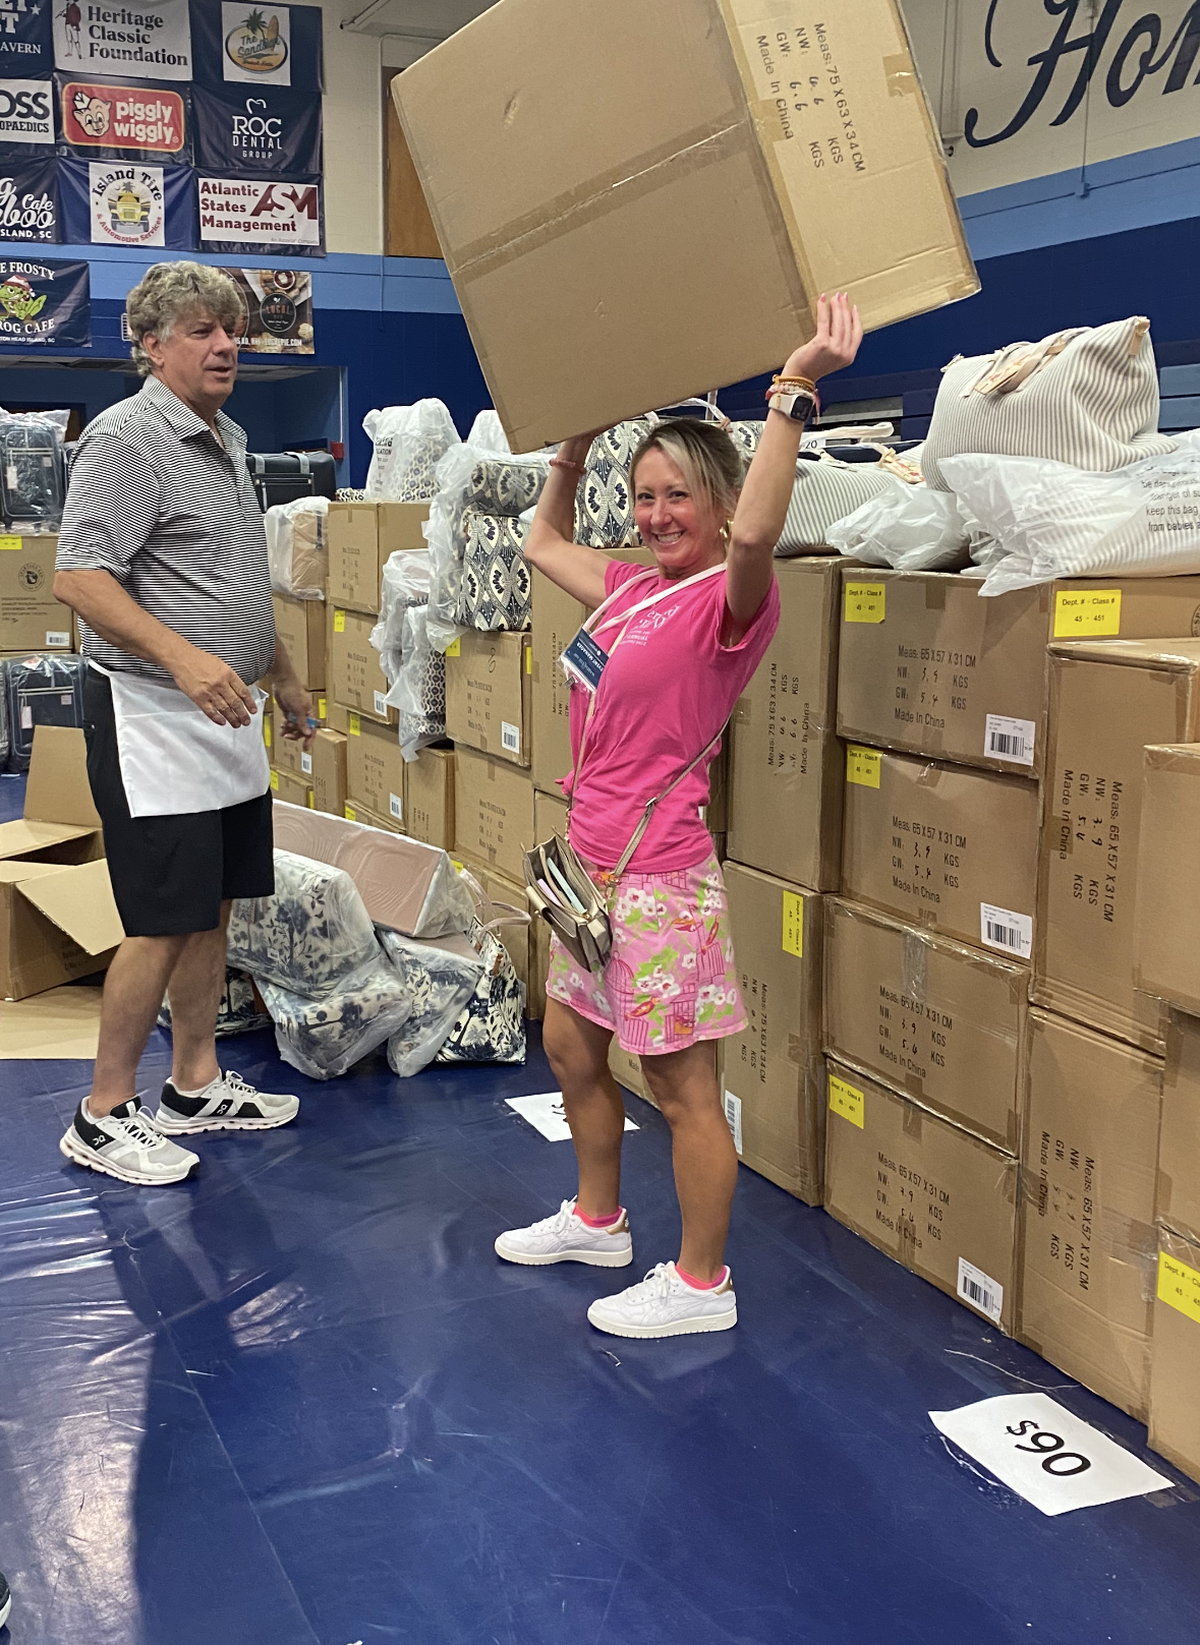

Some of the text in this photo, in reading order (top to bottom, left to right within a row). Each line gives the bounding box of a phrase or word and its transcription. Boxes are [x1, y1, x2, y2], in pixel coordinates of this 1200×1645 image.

[88, 6, 163, 31] Heritage
[89, 25, 151, 44] Classic
[241, 34, 257, 46] The
[814, 23, 832, 64] Meas:
[89, 42, 188, 66] Foundation
[827, 66, 840, 85] 75
[757, 36, 794, 139] Made In China
[795, 27, 810, 54] NW:
[828, 138, 843, 163] KGS
[777, 32, 791, 57] GW:
[809, 141, 824, 168] KGS
[837, 100, 850, 118] 63
[116, 98, 172, 123] piggly
[114, 119, 173, 144] wiggly
[232, 116, 281, 137] ROC
[233, 135, 282, 149] DENTAL
[846, 132, 859, 150] 34
[243, 150, 272, 159] GROUP
[852, 152, 866, 172] CM
[92, 168, 162, 201] Island Tire
[201, 182, 259, 197] Atlantic
[0, 194, 56, 228] boo
[22, 193, 53, 214] Cafe
[202, 198, 246, 212] States
[250, 184, 317, 220] ASM
[100, 221, 139, 242] Automotive
[140, 216, 162, 240] Services
[202, 215, 296, 232] Management
[9, 262, 55, 280] FROSTY
[25, 319, 55, 334] CAFE
[1146, 505, 1198, 516] keep this bag
[1148, 522, 1164, 531] from
[898, 645, 918, 659] Meas:
[920, 648, 929, 660] 65
[936, 650, 945, 662] 57
[954, 653, 962, 666] 31
[966, 654, 976, 668] CM
[953, 675, 968, 688] KGS
[951, 696, 966, 709] KGS
[802, 702, 810, 730] China
[894, 708, 944, 728] Made In China
[1111, 781, 1123, 819] Meas:
[1060, 770, 1074, 860] Made In China
[893, 816, 910, 832] Meas:
[913, 823, 920, 834] 65
[927, 827, 936, 839] 57
[944, 832, 952, 845] 31
[955, 835, 966, 849] CM
[1110, 825, 1119, 841] 65
[944, 853, 959, 867] KGS
[1108, 854, 1118, 869] 57
[893, 876, 940, 903] Made In China
[944, 874, 959, 888] KGS
[1074, 874, 1083, 899] KGS
[1089, 879, 1099, 906] KGS
[1105, 884, 1116, 899] 31
[1104, 904, 1114, 922] CM
[880, 986, 899, 1004] Meas:
[932, 1011, 939, 1023] 31
[942, 1016, 952, 1030] CM
[932, 1031, 946, 1047] KGS
[880, 1044, 926, 1078] Made In China
[931, 1050, 945, 1067] KGS
[878, 1152, 937, 1197] Meas: 65 57 31
[876, 1209, 894, 1230] Made
[929, 1204, 943, 1221] KGS
[928, 1223, 941, 1240] KGS
[1005, 1420, 1091, 1476] $90
